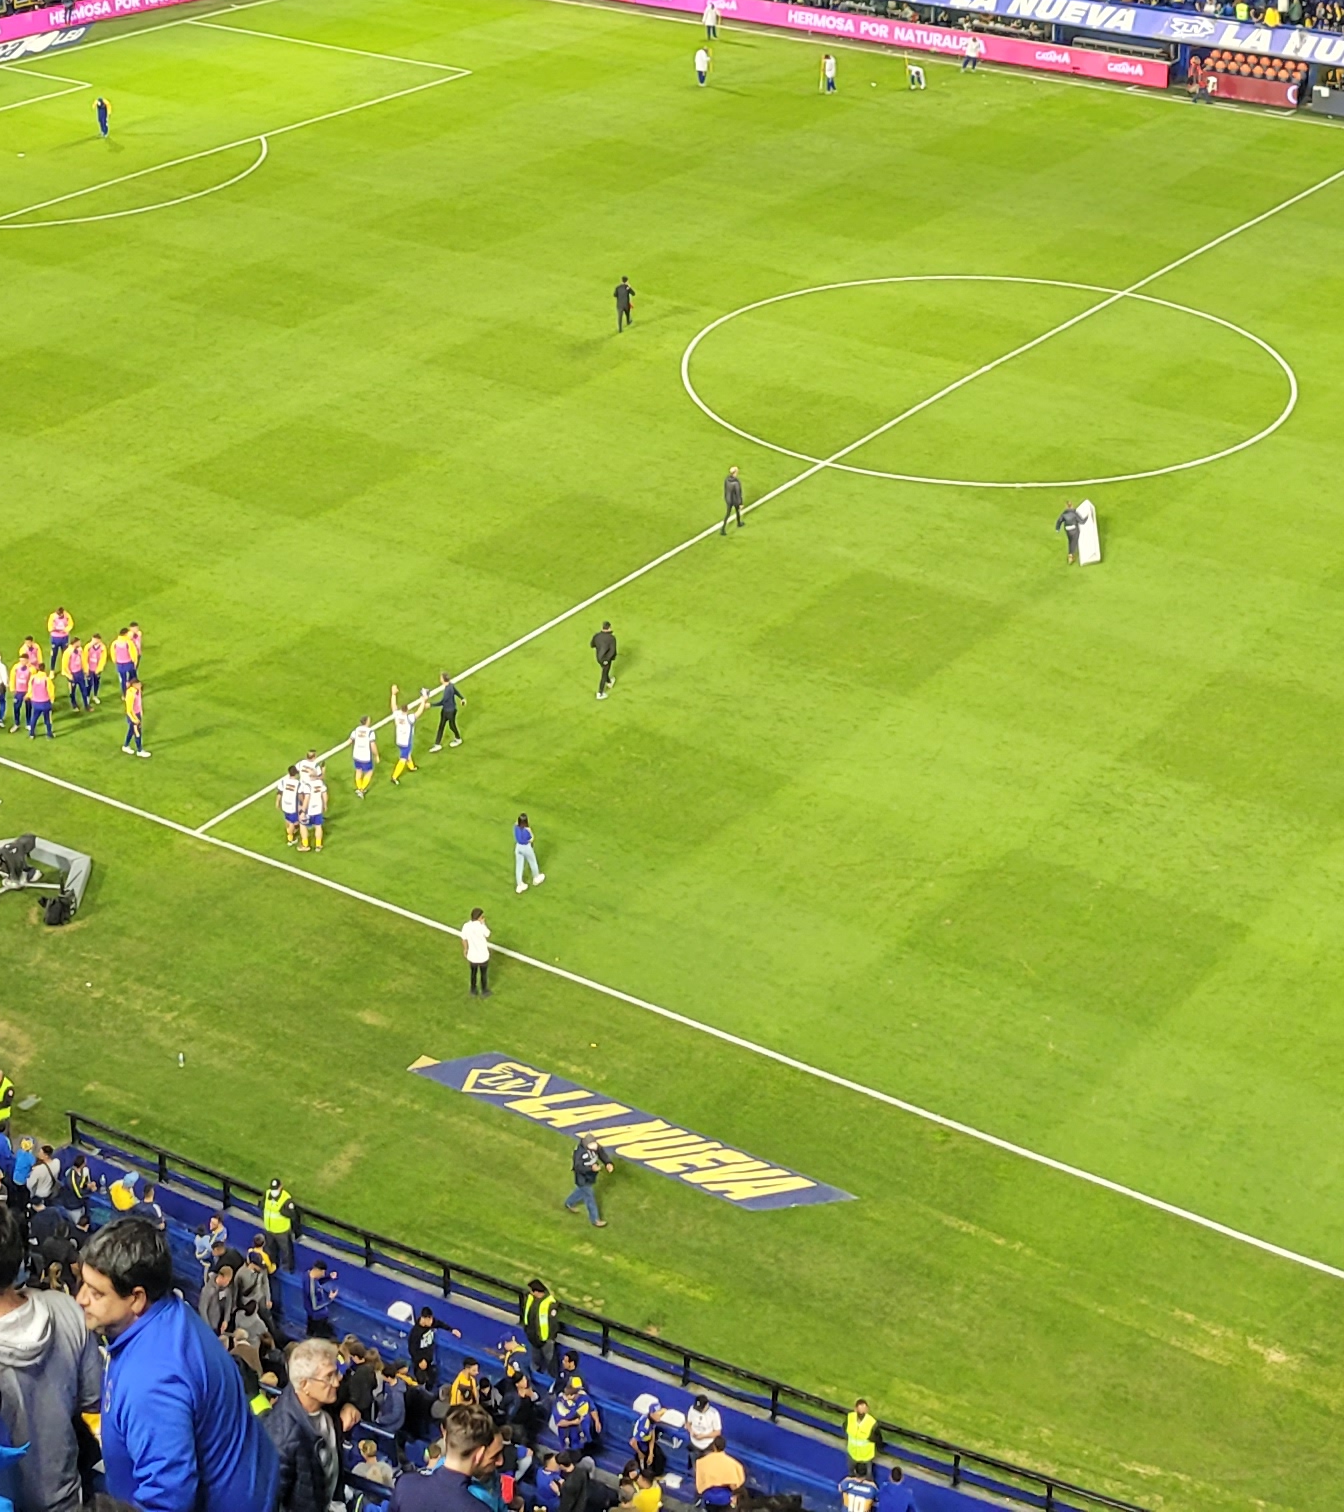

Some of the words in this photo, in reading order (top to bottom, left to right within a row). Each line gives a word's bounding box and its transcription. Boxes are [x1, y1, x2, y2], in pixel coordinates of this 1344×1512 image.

[787, 11, 854, 33] HERMOSA
[860, 21, 889, 38] POR
[1218, 23, 1273, 51] LA
[1035, 50, 1070, 65] CATAMA
[1108, 61, 1143, 77] CATAMA
[504, 1090, 633, 1127] LA
[577, 1118, 817, 1201] NUEVA
